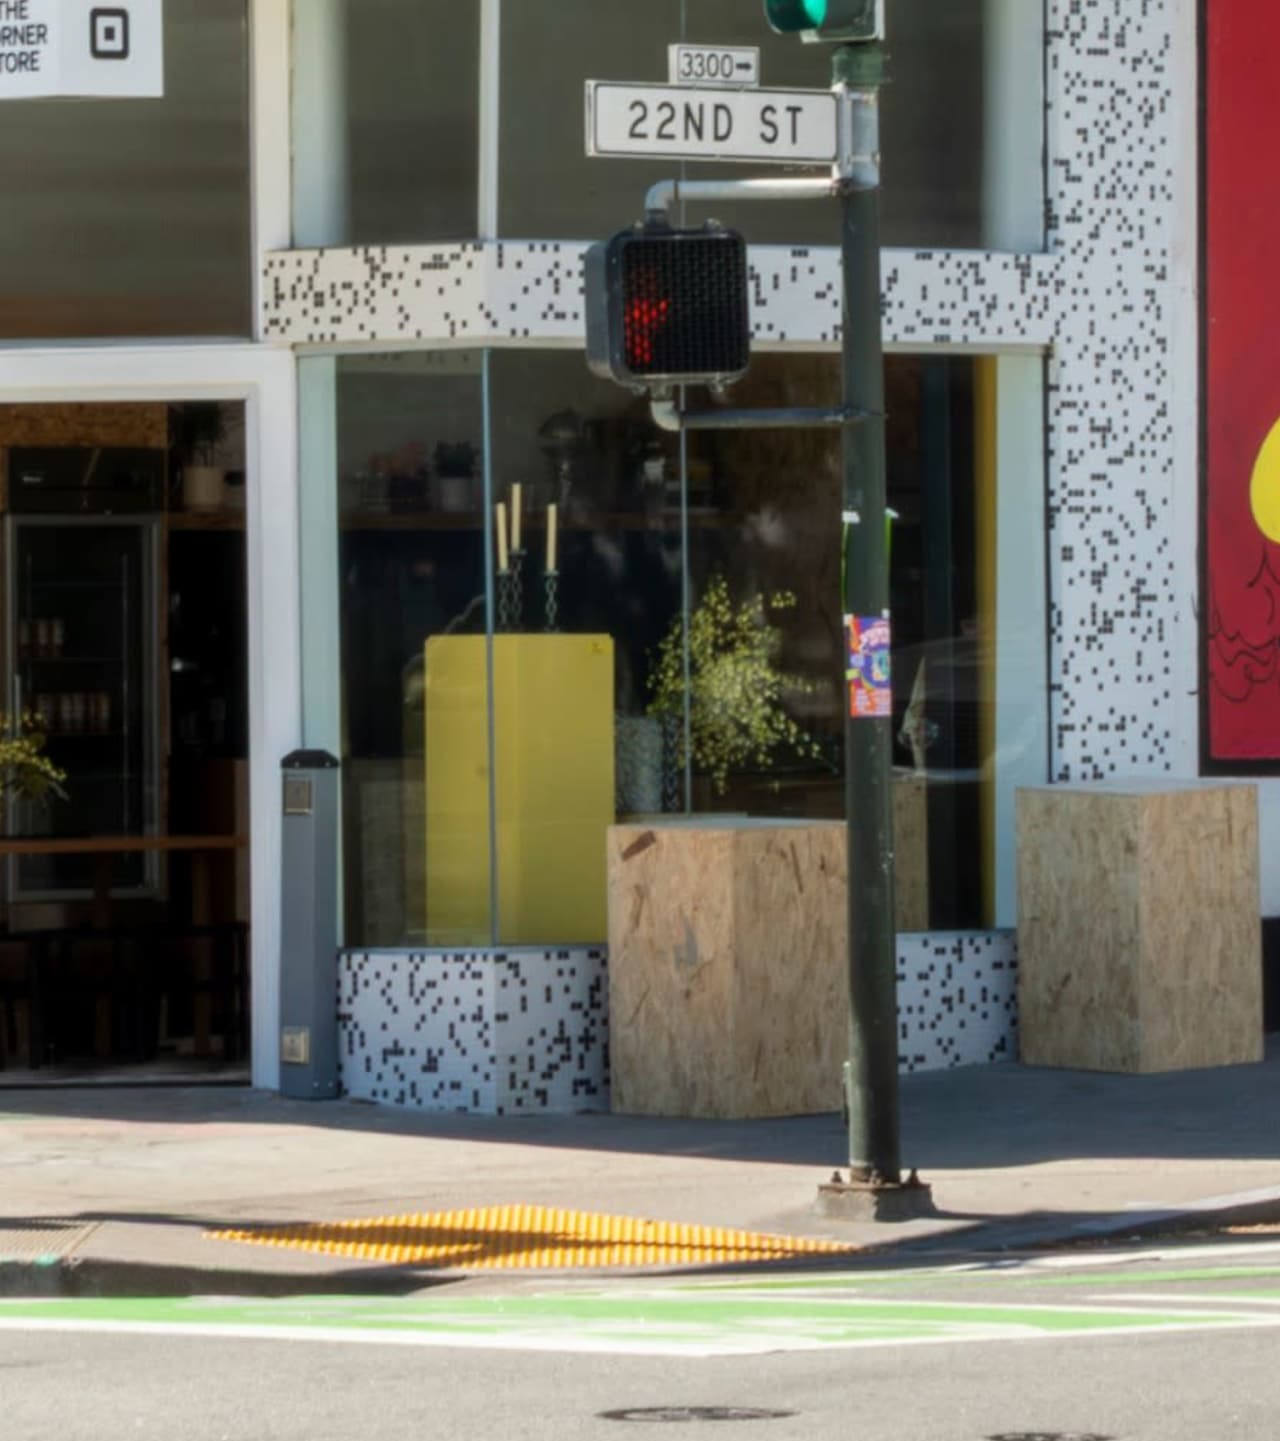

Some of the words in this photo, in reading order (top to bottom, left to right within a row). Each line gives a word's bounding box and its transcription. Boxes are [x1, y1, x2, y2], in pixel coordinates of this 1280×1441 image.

[682, 53, 734, 78] 3300
[628, 100, 733, 142] 22ND
[760, 105, 803, 145] ST
